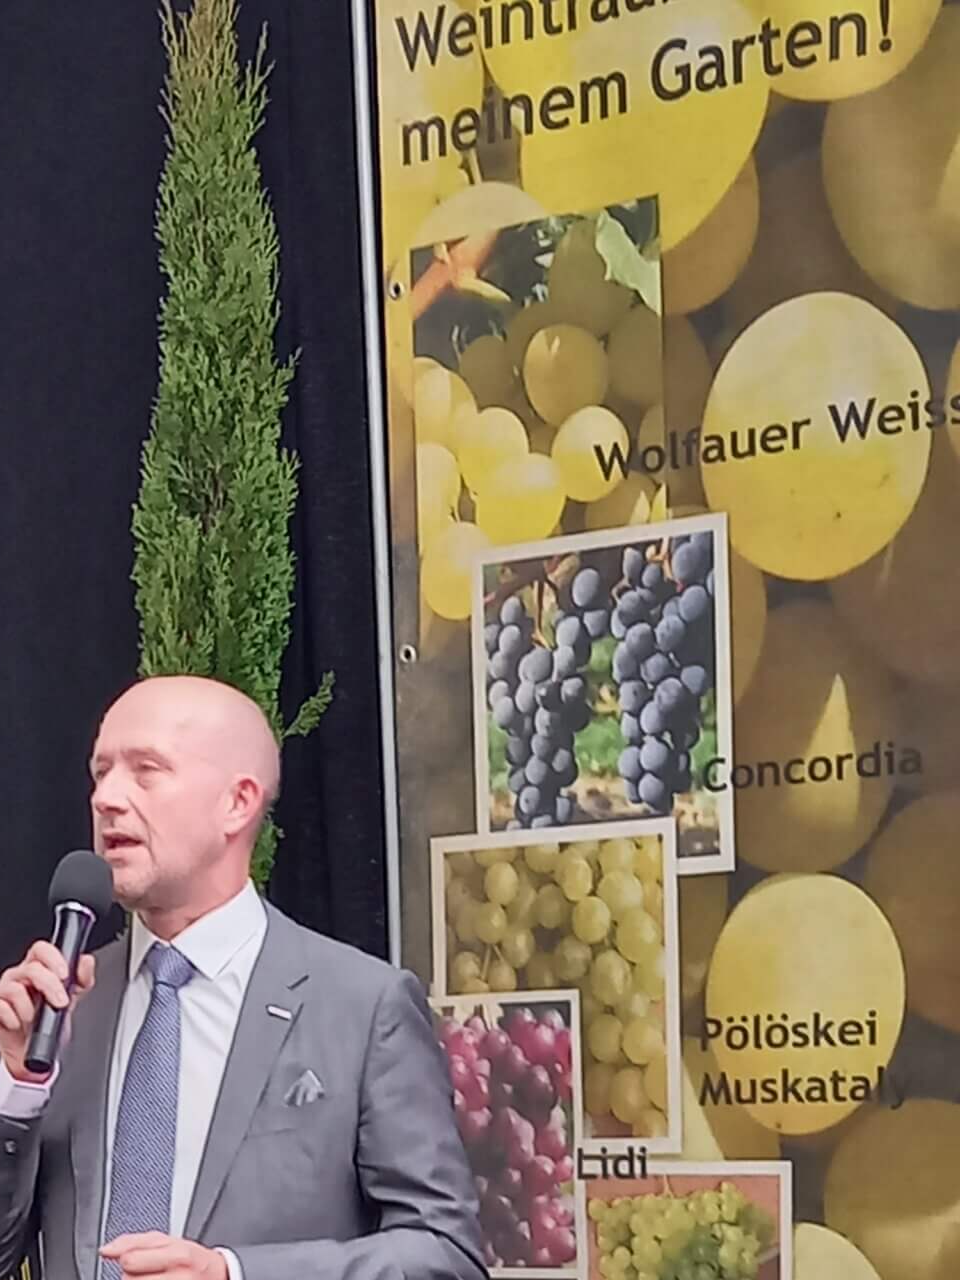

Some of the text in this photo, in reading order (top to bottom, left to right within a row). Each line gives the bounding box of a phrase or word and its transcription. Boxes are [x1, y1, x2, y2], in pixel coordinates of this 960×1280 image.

[396, 0, 670, 72] Weintra
[402, 0, 893, 166] meinem Garten!
[593, 418, 811, 481] Wolfauer
[703, 741, 923, 792] Concordia
[700, 1010, 878, 1052] Pölöskei
[576, 1146, 648, 1180] Lidi
